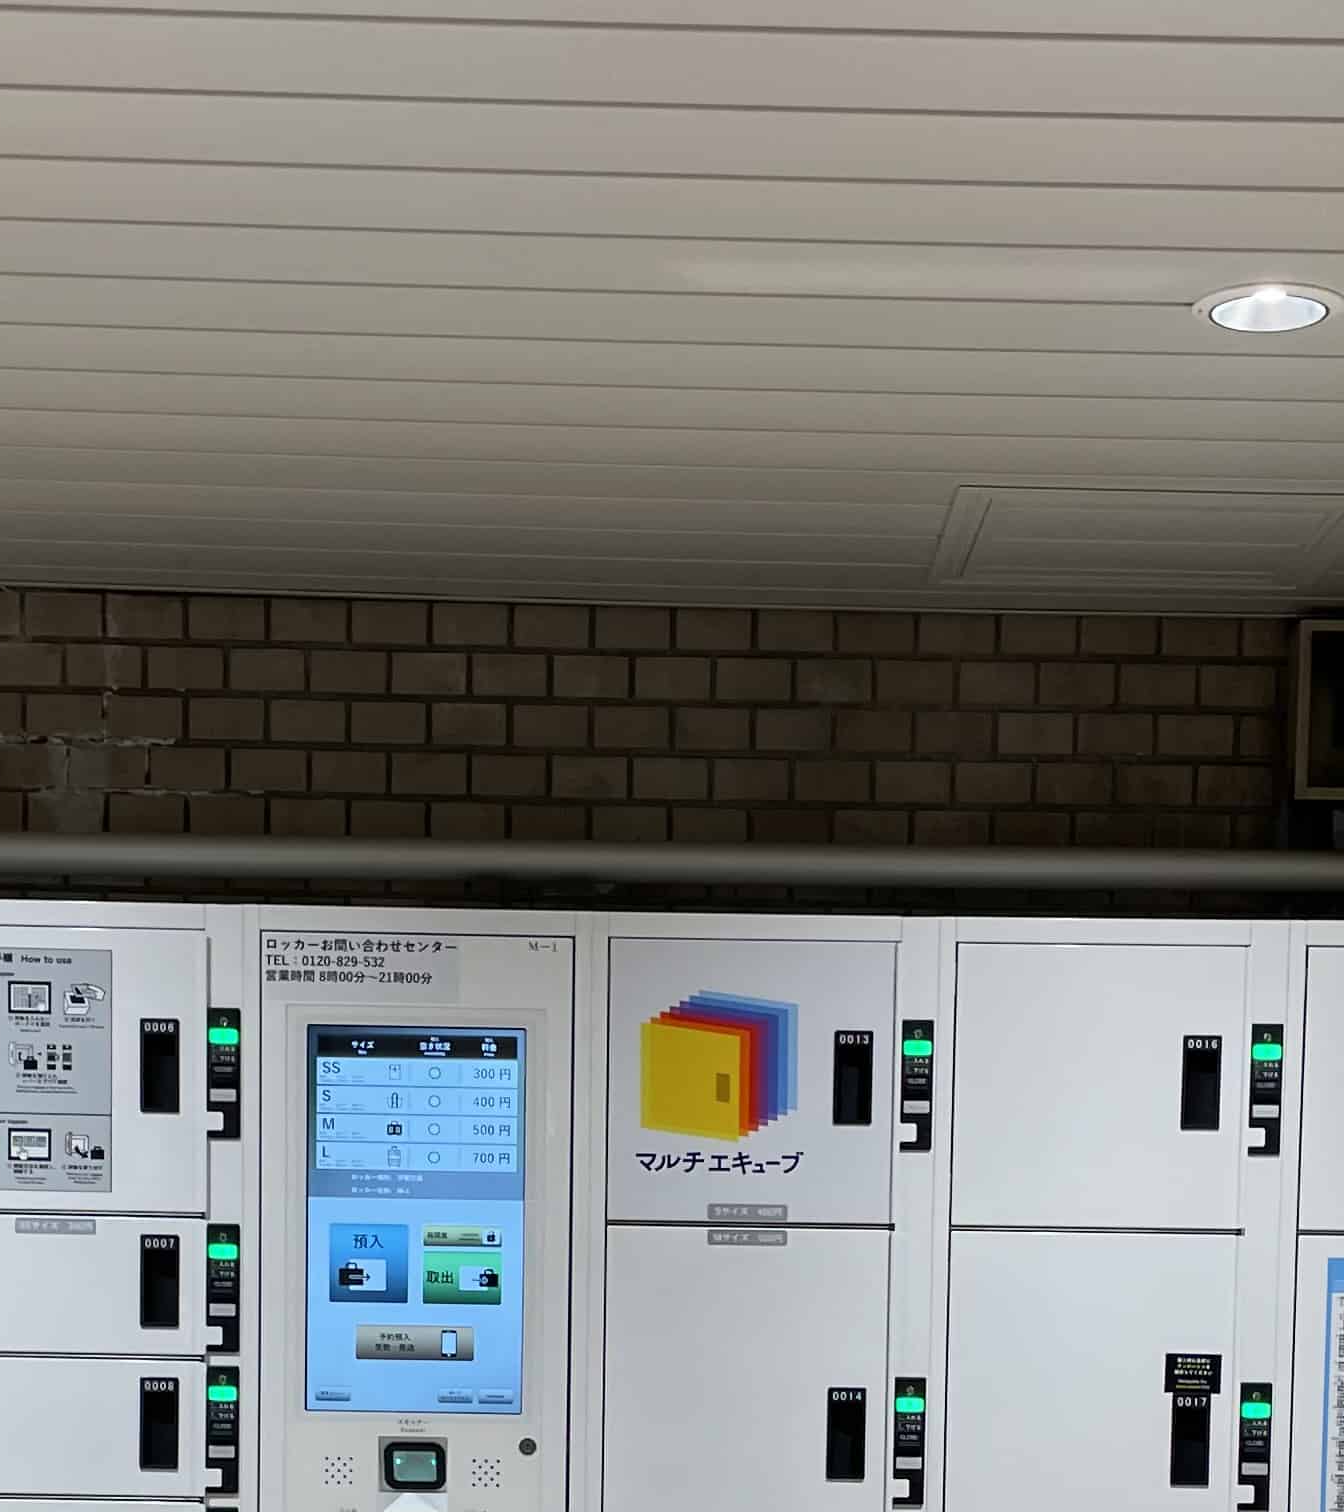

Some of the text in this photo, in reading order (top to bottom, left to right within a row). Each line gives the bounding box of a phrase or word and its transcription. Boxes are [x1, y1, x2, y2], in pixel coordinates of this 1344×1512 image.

[266, 939, 457, 953] ロッカーお問い合わせセンター
[144, 1021, 174, 1033] 0006
[840, 1034, 869, 1045] 0013
[1188, 1038, 1217, 1049] 0016
[322, 1061, 341, 1074] SS
[473, 1068, 511, 1081] 300 円
[322, 1090, 332, 1102] S
[473, 1096, 511, 1109] 400 円
[322, 1118, 335, 1130] M
[472, 1124, 511, 1137] 500 円
[322, 1146, 330, 1158] L
[472, 1152, 511, 1165] 700 円
[635, 1151, 804, 1174] マルチエキューブ
[145, 1237, 174, 1249] 0007
[352, 1234, 384, 1250] 預入
[426, 1270, 454, 1284] 取出
[144, 1380, 174, 1392] 0008
[833, 1391, 861, 1401] 0014
[1177, 1396, 1207, 1408] 0017
